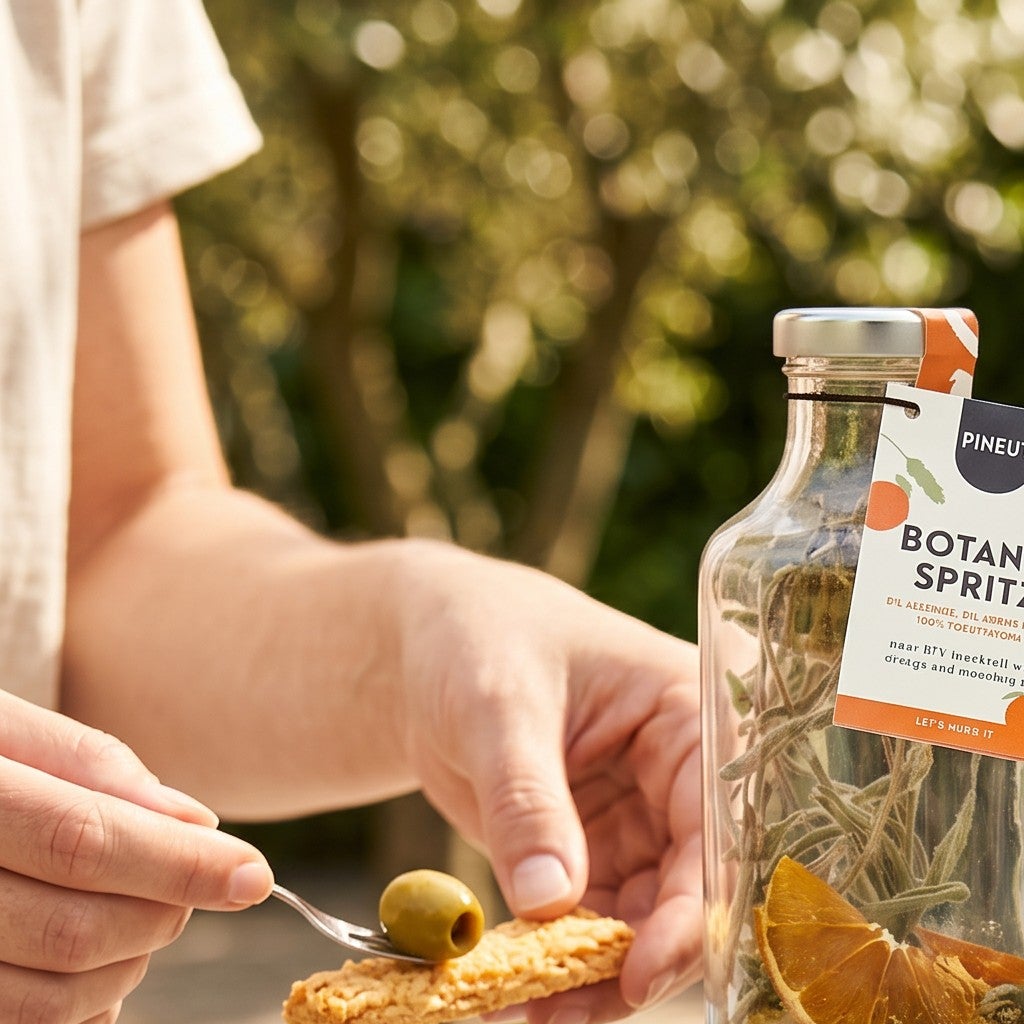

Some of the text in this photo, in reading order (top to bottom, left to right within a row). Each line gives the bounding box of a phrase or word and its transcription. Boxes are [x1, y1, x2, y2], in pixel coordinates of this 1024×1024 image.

[889, 640, 919, 652] naar
[931, 663, 955, 675] and
[983, 729, 994, 739] IT
